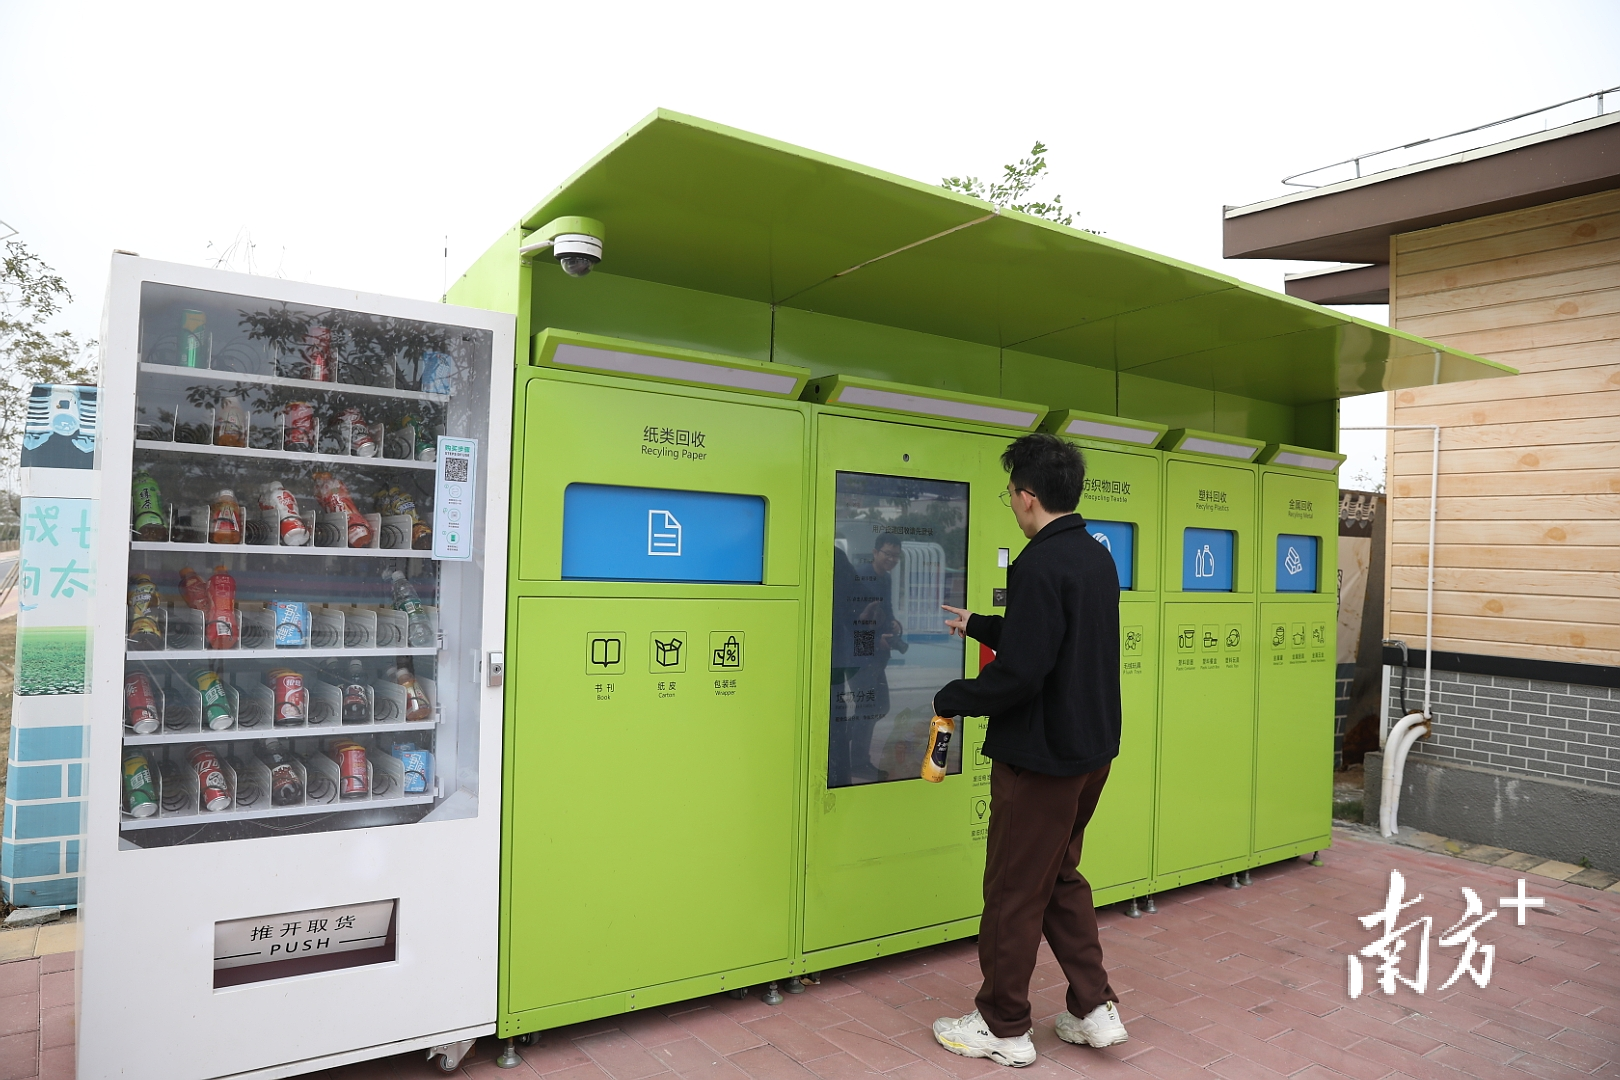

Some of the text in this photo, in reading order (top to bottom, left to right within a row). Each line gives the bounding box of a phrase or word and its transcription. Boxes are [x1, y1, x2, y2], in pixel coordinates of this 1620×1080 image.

[643, 425, 706, 448] 纸类回收
[445, 444, 471, 453] 购买步骤
[641, 444, 707, 462] Recyling Paper
[1198, 489, 1228, 503] 塑料回收
[1288, 499, 1313, 511] 金属回收
[1303, 511, 1314, 519] Metal
[594, 683, 615, 693] 书刊
[657, 681, 676, 691] 纸皮
[714, 679, 737, 689] 包装纸
[250, 915, 356, 941] 推开取货
[270, 937, 330, 956] PUSH
